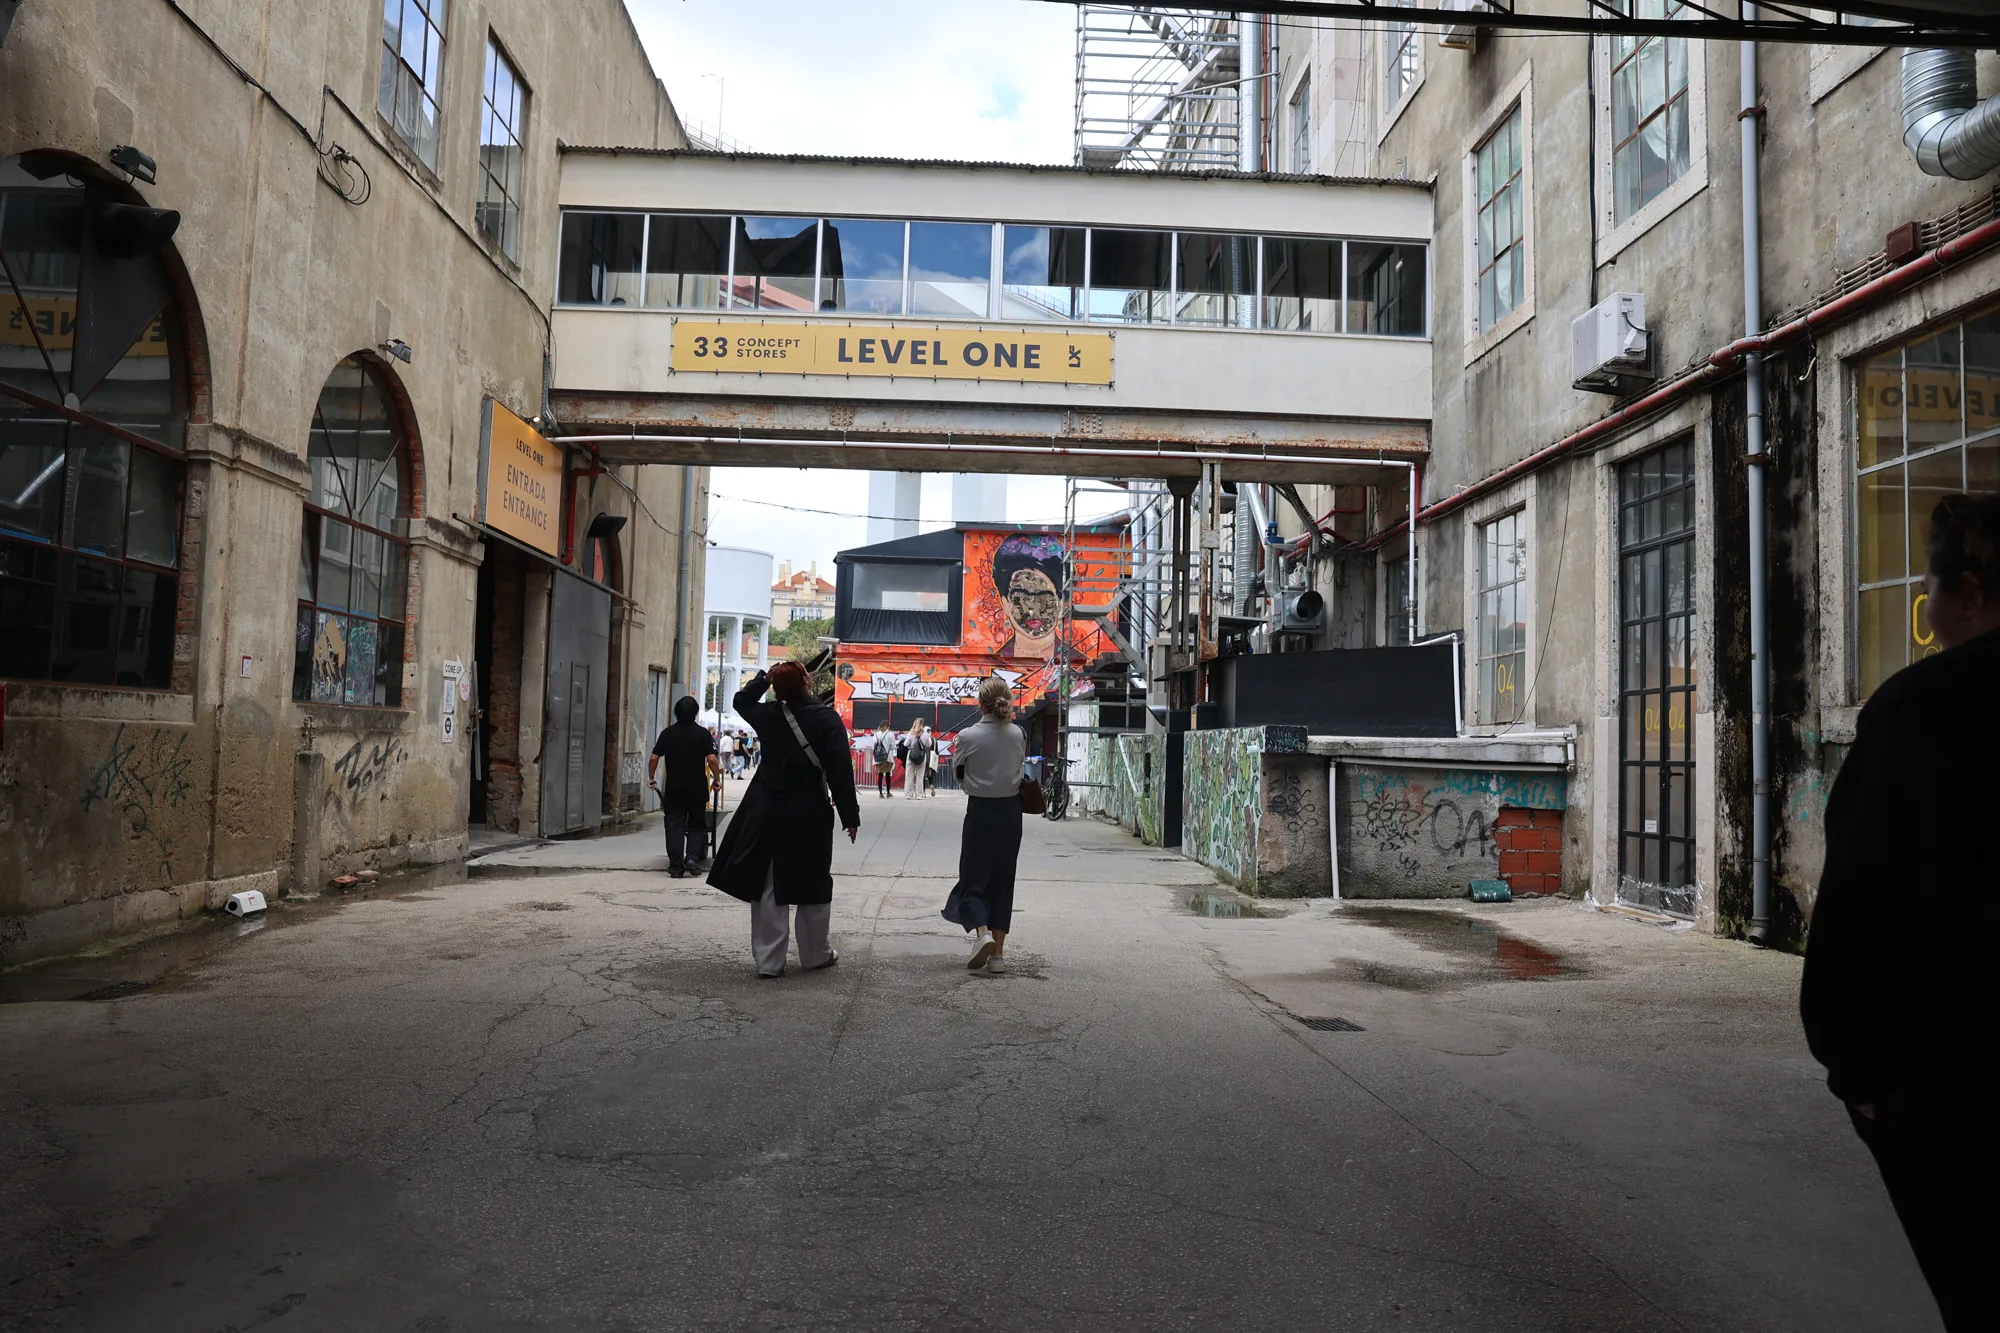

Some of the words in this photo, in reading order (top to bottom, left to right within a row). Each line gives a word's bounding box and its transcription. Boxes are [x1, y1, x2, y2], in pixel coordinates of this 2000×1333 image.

[693, 337, 728, 358] 33
[736, 348, 787, 359] STORES
[737, 337, 801, 349] CONCEPT
[838, 338, 948, 366] LEVEL
[963, 341, 1041, 369] ONE
[516, 438, 532, 459] LEVEL
[532, 450, 544, 466] ONE
[507, 463, 546, 504] ENTRADA
[503, 490, 548, 531] ENTRANCE
[445, 664, 456, 674] COME
[456, 665, 462, 674] UP
[1497, 663, 1513, 694] 04
[1645, 708, 1660, 731] 04
[1669, 706, 1685, 731] 04
